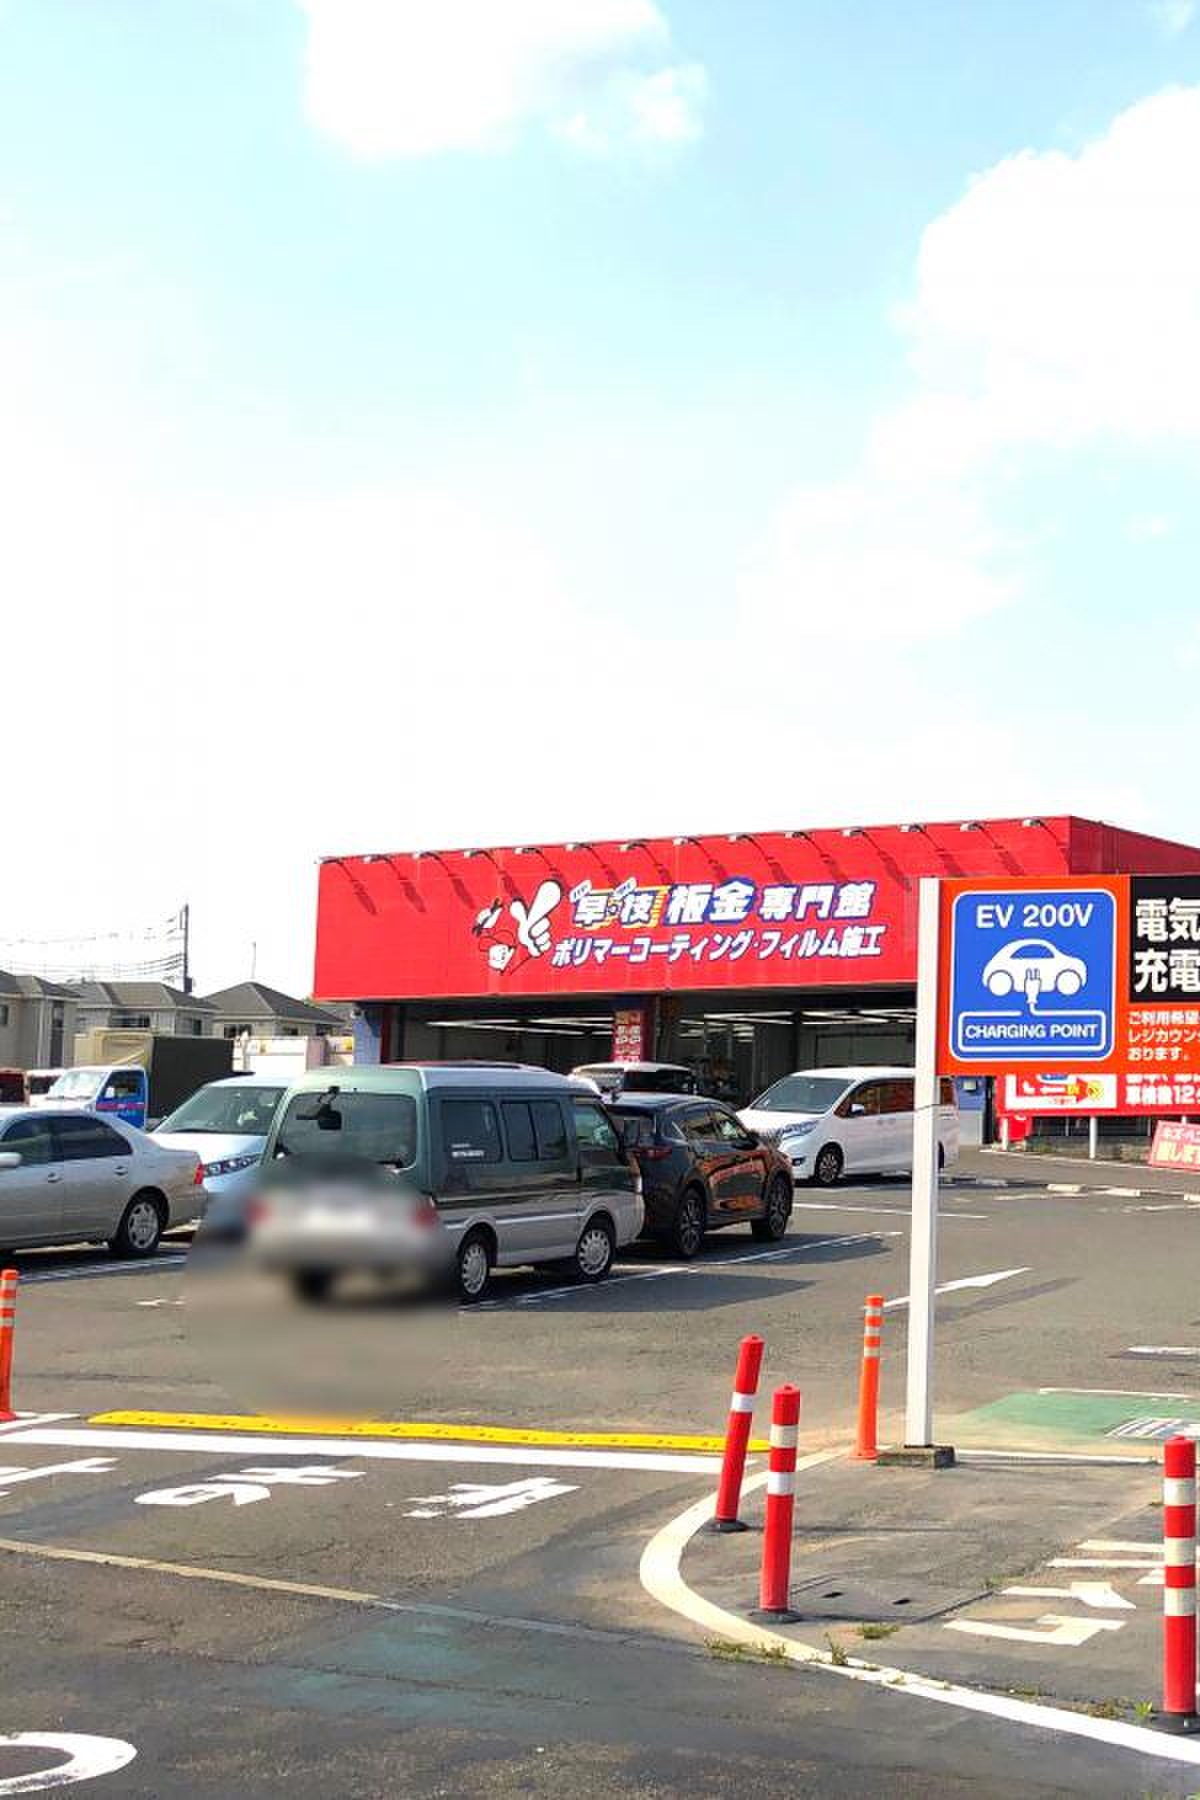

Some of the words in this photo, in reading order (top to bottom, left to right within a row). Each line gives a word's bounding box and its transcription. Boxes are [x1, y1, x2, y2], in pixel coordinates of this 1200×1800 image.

[976, 905, 1014, 929] EV
[1023, 903, 1095, 928] 200V
[965, 1024, 1046, 1041] CHARGING
[1050, 1023, 1098, 1040] POINT
[1127, 1047, 1190, 1062] おります。
